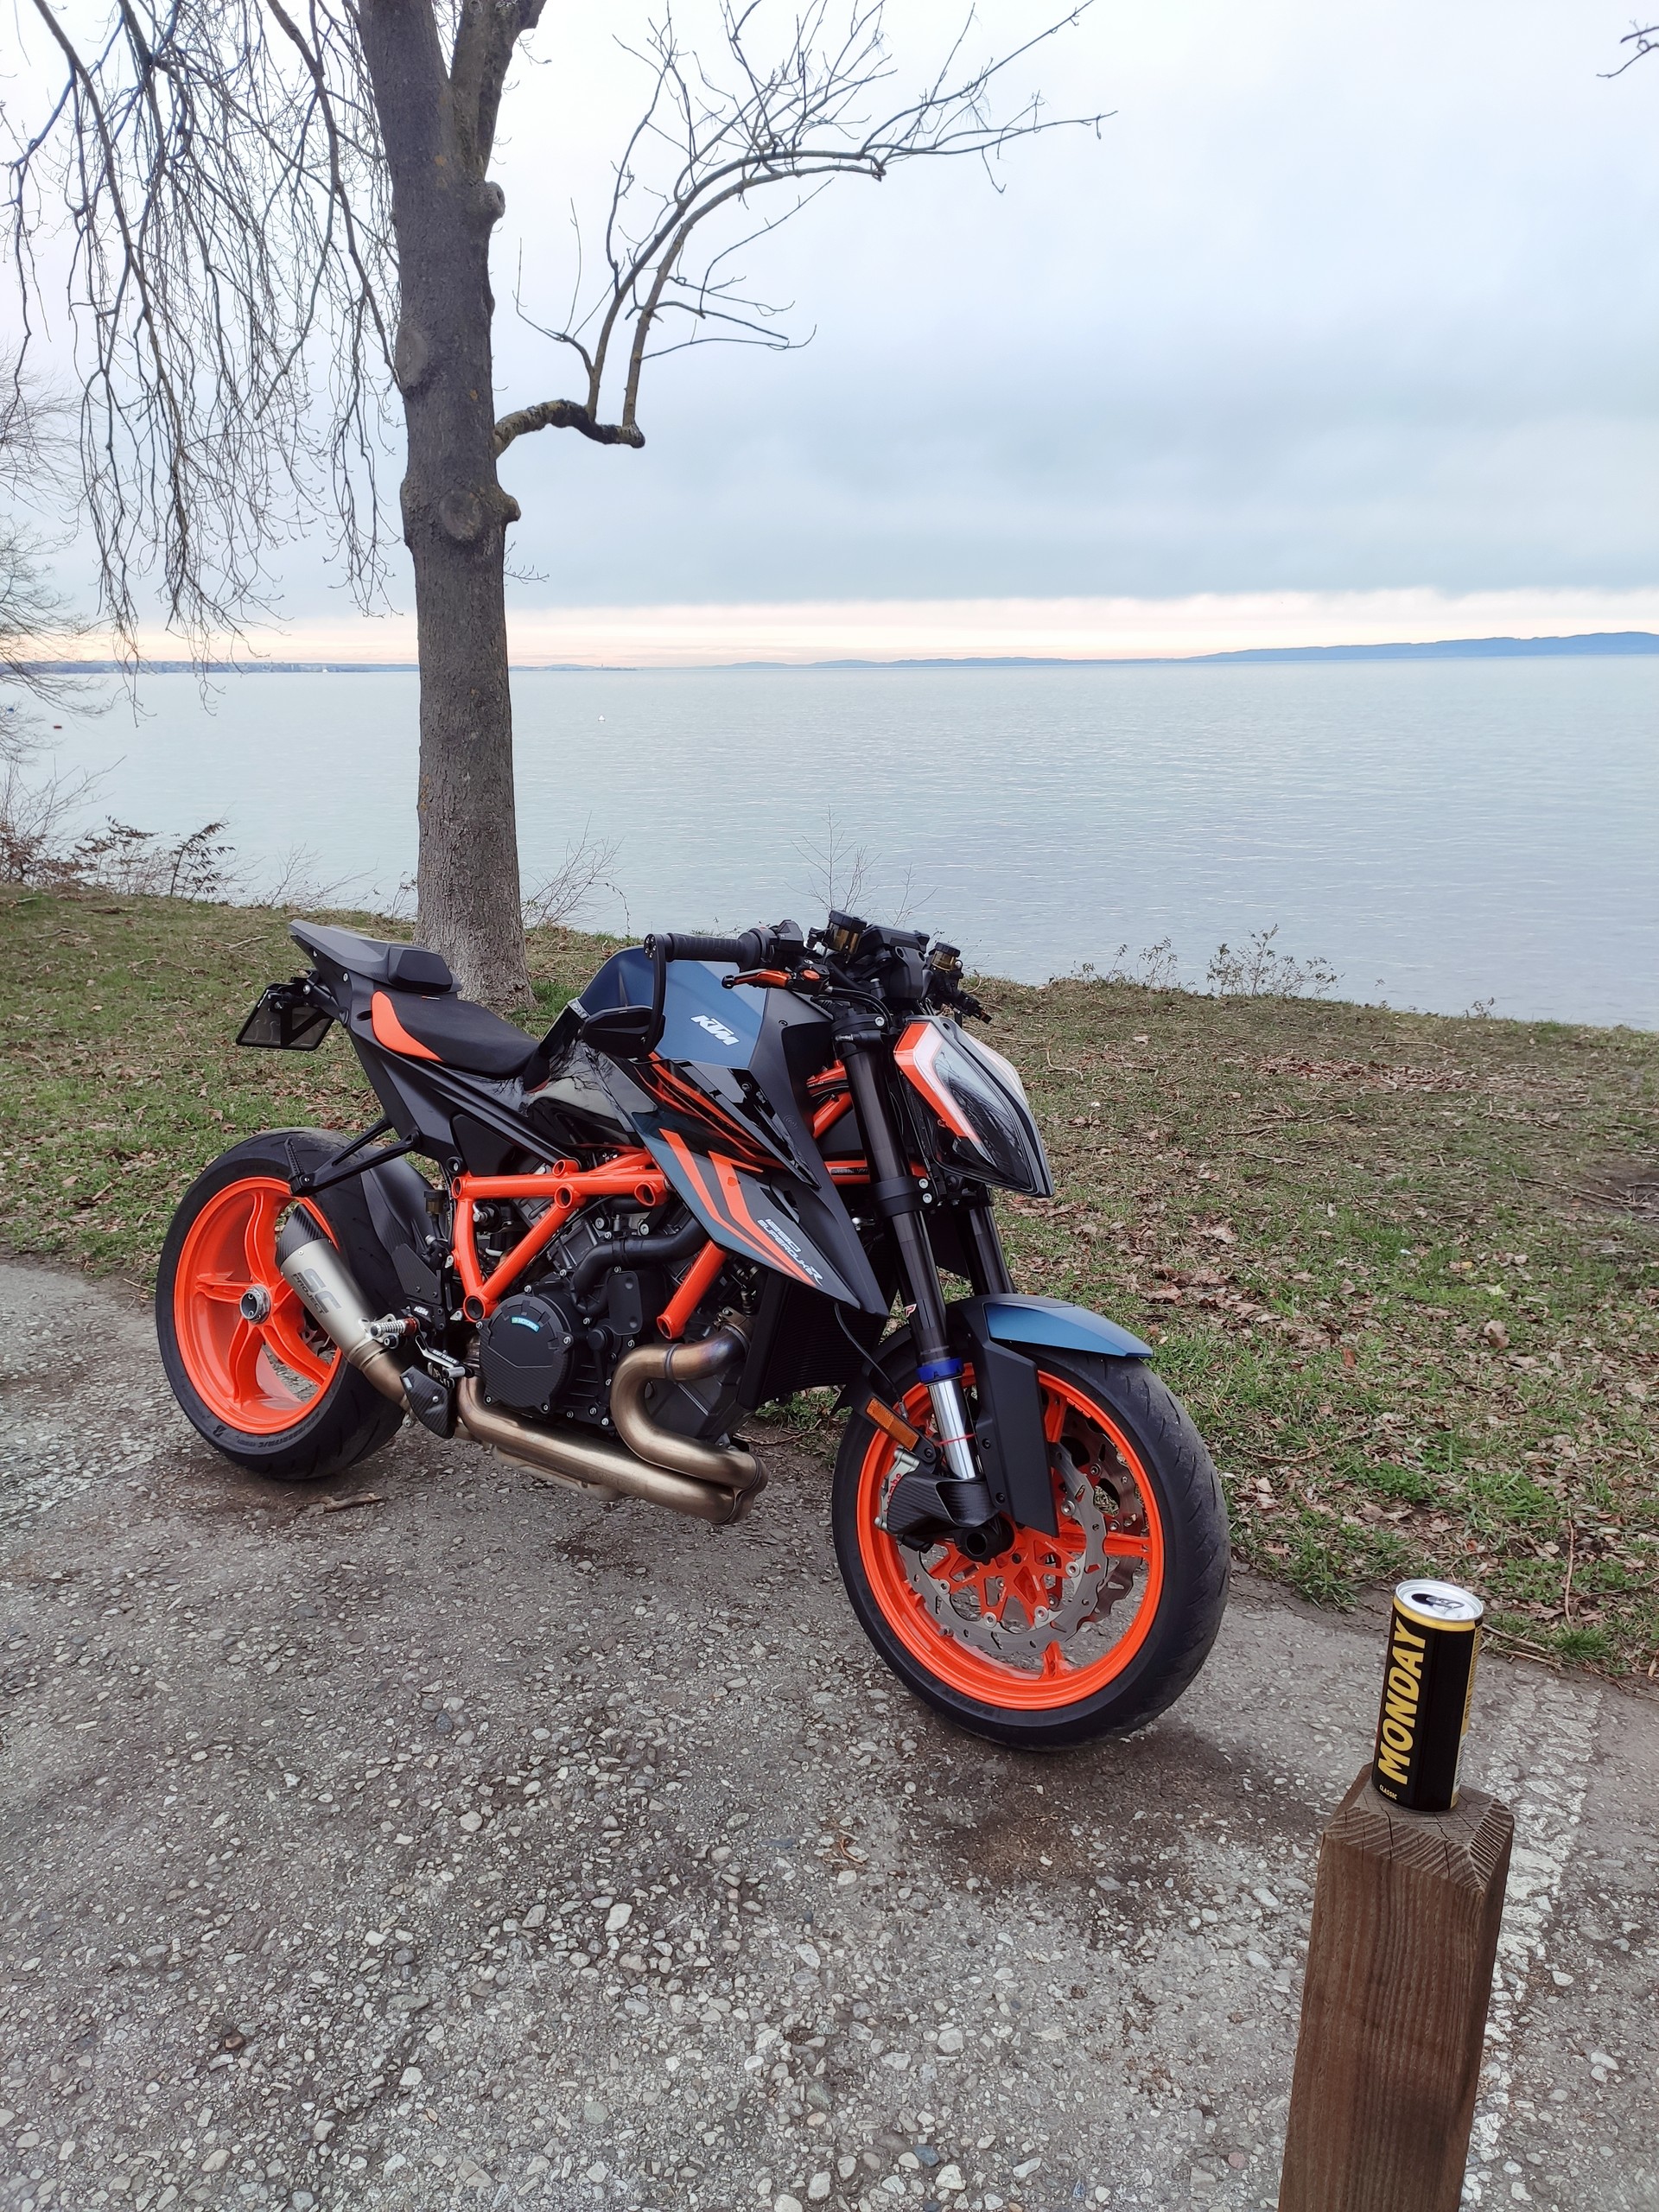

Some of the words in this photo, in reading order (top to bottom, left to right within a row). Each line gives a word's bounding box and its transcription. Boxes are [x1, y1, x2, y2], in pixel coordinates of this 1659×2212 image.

[690, 1014, 741, 1046] KTM
[290, 1274, 326, 1314] PROJECT
[1377, 1617, 1426, 1784] MONDAY
[1379, 1784, 1398, 1800] CLASSIC
